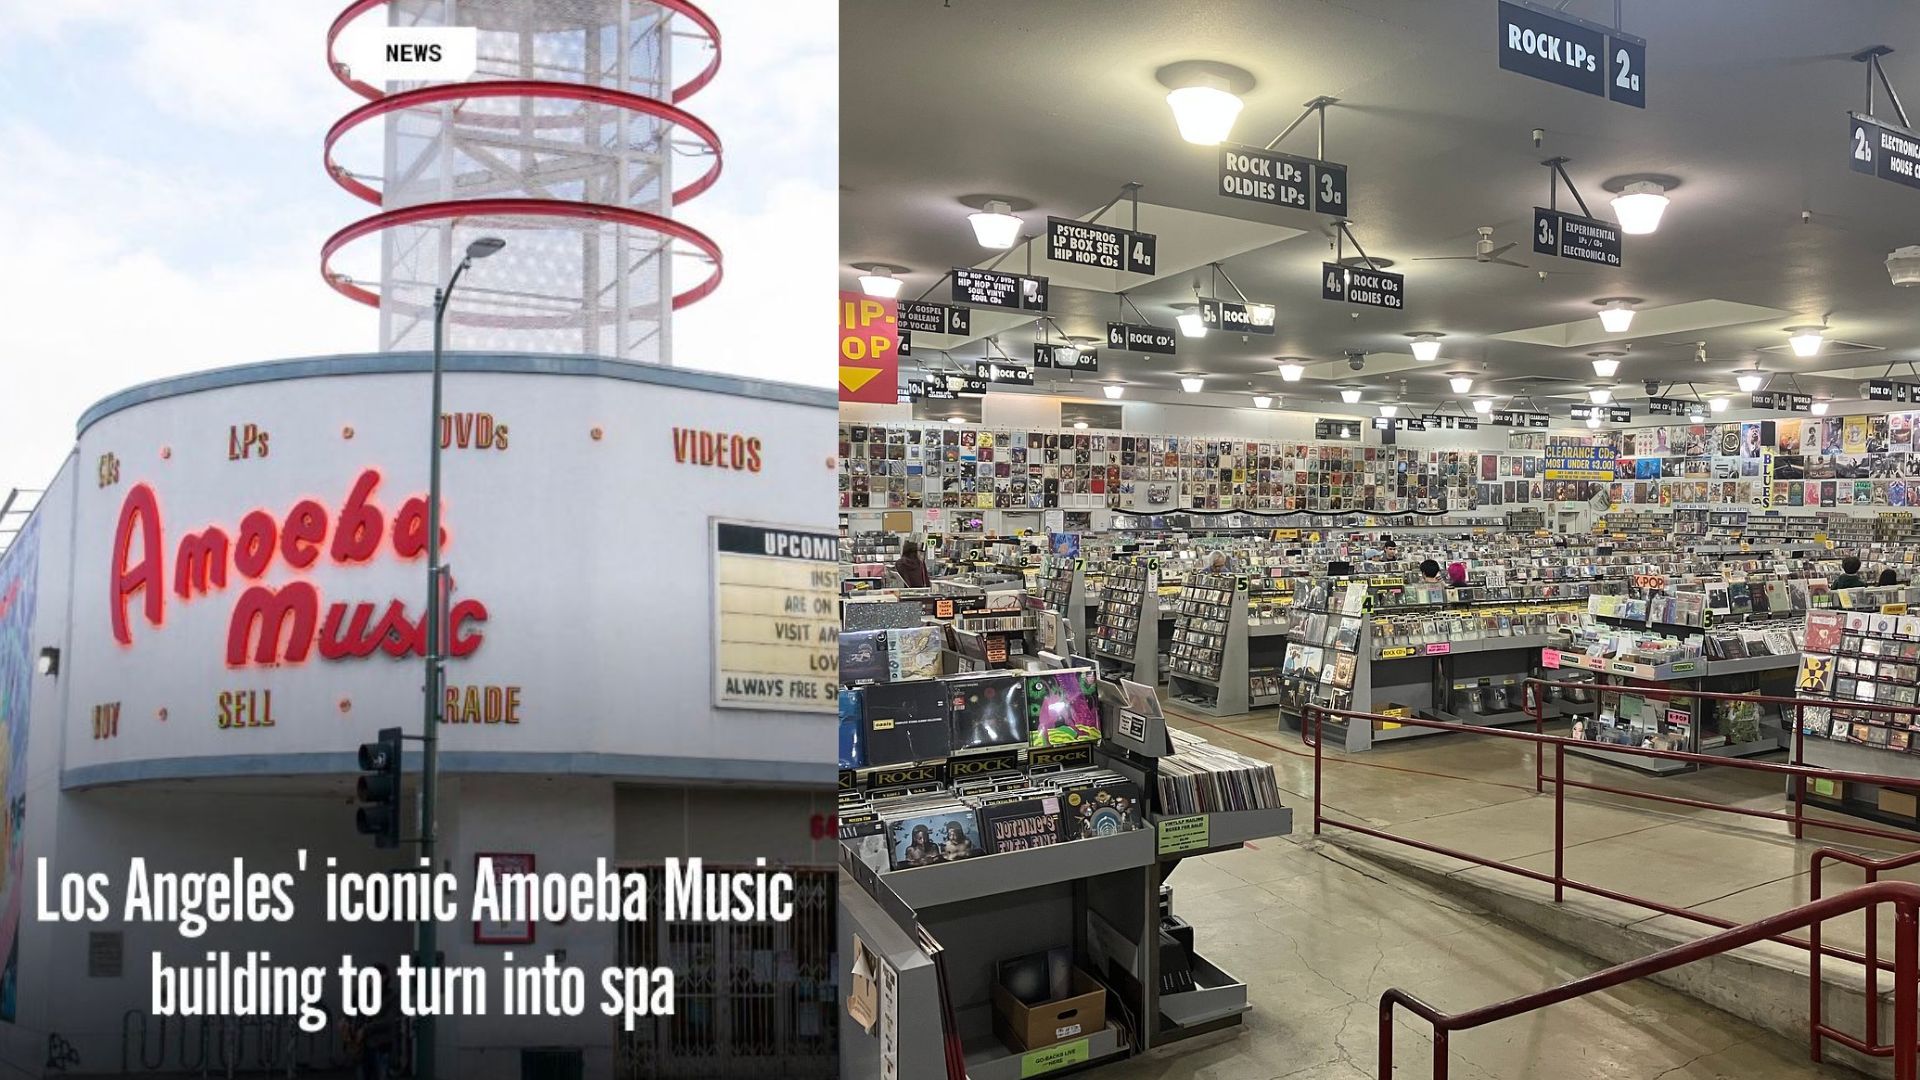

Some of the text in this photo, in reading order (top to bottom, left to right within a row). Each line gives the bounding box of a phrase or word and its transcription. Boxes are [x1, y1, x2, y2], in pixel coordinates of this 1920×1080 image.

[1508, 23, 1596, 72] ROCK LPs
[1616, 49, 1639, 91] 2a
[1855, 127, 1871, 162] 2b
[1226, 152, 1302, 183] ROCK LPs
[1890, 156, 1913, 176] HOUSE
[1223, 175, 1305, 205] OLDIES LPs
[1320, 173, 1341, 204] 3a
[1057, 224, 1116, 243] PSYCH-PROG
[1538, 219, 1554, 245] 3b
[1565, 222, 1616, 242] EXPERIMENTAL
[1053, 235, 1120, 256] LP BOX SETS
[1133, 241, 1151, 266] 4a
[1563, 245, 1620, 264] ELECTRONICA CDs
[1054, 248, 1119, 267] HIP HOP CDs
[958, 278, 1015, 292] HIP HOP VINYL
[970, 272, 982, 280] HOP
[1326, 272, 1341, 293] 4b
[1353, 274, 1398, 292] ROCK CDs
[968, 287, 1005, 298] SOUL VINYL
[971, 294, 988, 302] SOUL
[1350, 289, 1401, 307] OLDIES CDs
[844, 300, 896, 330] IP-
[897, 303, 906, 311] UL
[915, 305, 942, 315] GOSPEL
[908, 312, 940, 323] ORLEANS
[1203, 304, 1217, 323] 5b
[1223, 310, 1250, 324] ROCK
[897, 320, 937, 331] OP VOCALS
[952, 312, 967, 329] 6a
[1110, 328, 1123, 344] 6b
[1129, 333, 1175, 347] ROCK CD's
[841, 335, 891, 360] OP
[1037, 349, 1049, 363] 7b
[1080, 355, 1097, 365] CD's
[978, 365, 989, 378] 8b
[1017, 369, 1033, 380] CD's
[970, 381, 986, 389] CD's
[439, 412, 509, 450] DVDs
[228, 424, 270, 460] LPs
[672, 426, 761, 472] VIDEOS
[1546, 446, 1615, 459] CLEARANCE CDs
[1545, 459, 1614, 470] MOST UNDER $3.00!
[1762, 454, 1771, 508] BLUES
[764, 532, 838, 561] UPCOMI
[970, 550, 979, 560] 9
[110, 469, 447, 644] Amoeba
[1075, 559, 1084, 571] 7
[1148, 558, 1158, 571] 6
[1238, 577, 1248, 591] 5
[784, 595, 832, 614] ARE ON
[1362, 597, 1373, 612] 4
[1704, 610, 1713, 628] 3
[775, 622, 811, 642] VISIT
[726, 678, 783, 697] ALWAYS
[790, 682, 817, 699] FREE
[219, 690, 275, 729] SELL
[441, 685, 521, 724] RADE
[953, 759, 1011, 774] ROCK
[1039, 751, 1088, 764] ROCK
[879, 769, 932, 784] ROCK
[995, 815, 1056, 840] NOTHING'S
